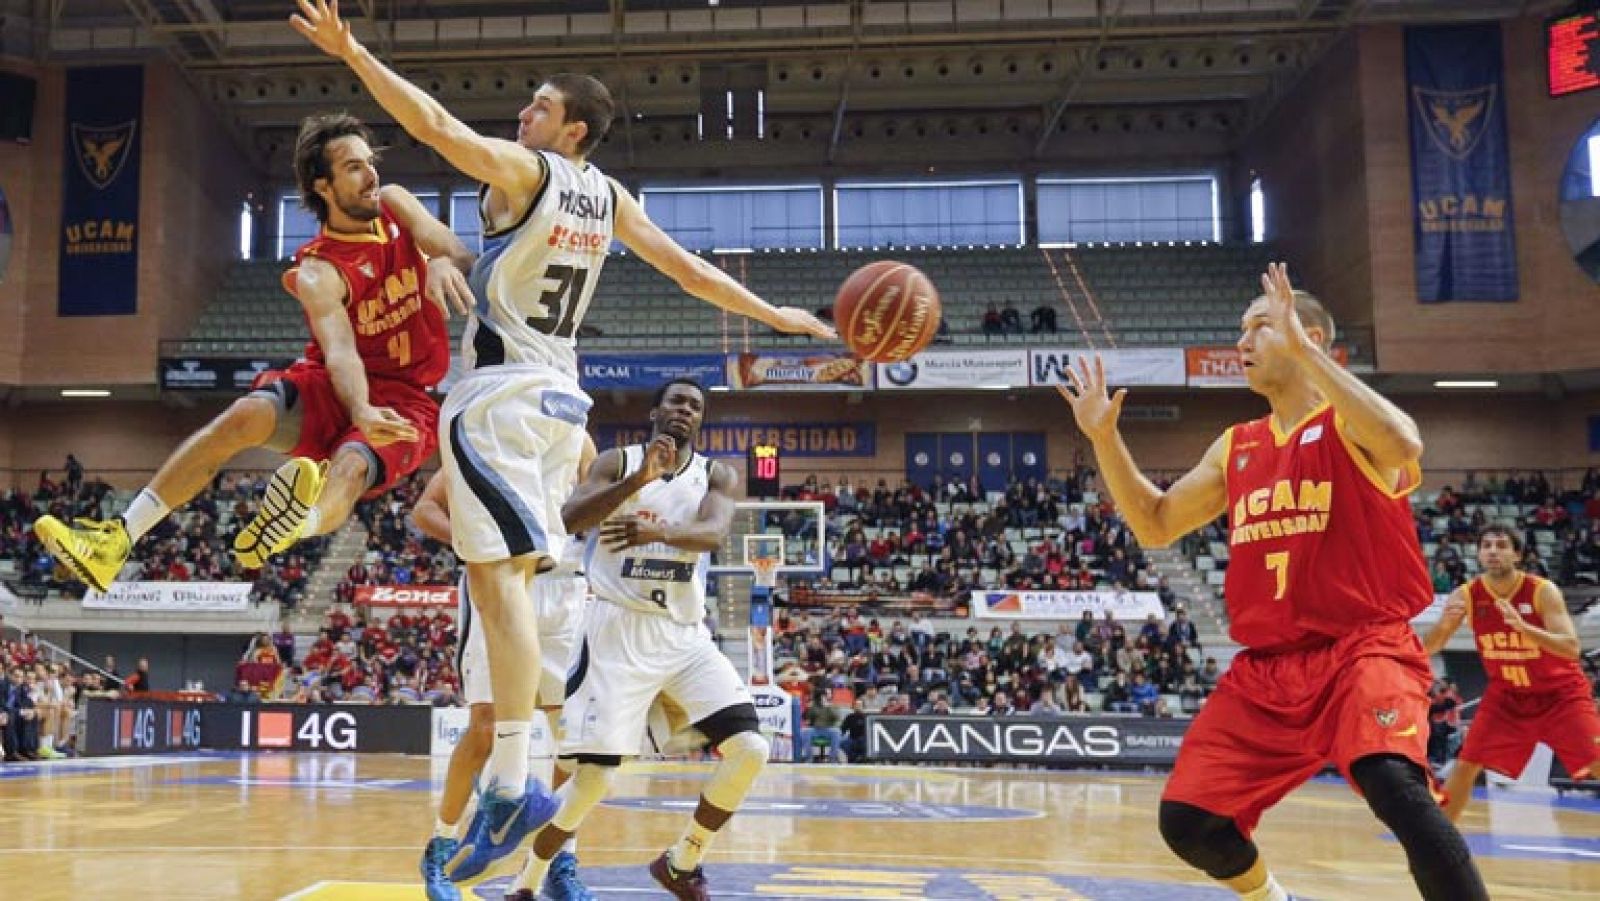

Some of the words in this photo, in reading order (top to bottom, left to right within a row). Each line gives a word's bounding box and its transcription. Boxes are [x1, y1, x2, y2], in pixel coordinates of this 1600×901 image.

[1418, 194, 1506, 219] UCAM
[65, 219, 135, 244] UCAM
[526, 264, 588, 338] 31
[386, 331, 411, 366] 4
[585, 365, 630, 379] UCAM
[695, 426, 857, 452] UNIVERSIDAD
[757, 458, 776, 479] 10
[1265, 551, 1290, 600] 7
[1501, 665, 1532, 688] 41
[133, 708, 155, 749] 4G
[297, 711, 358, 749] 4G
[871, 721, 1121, 757] MANGAS
